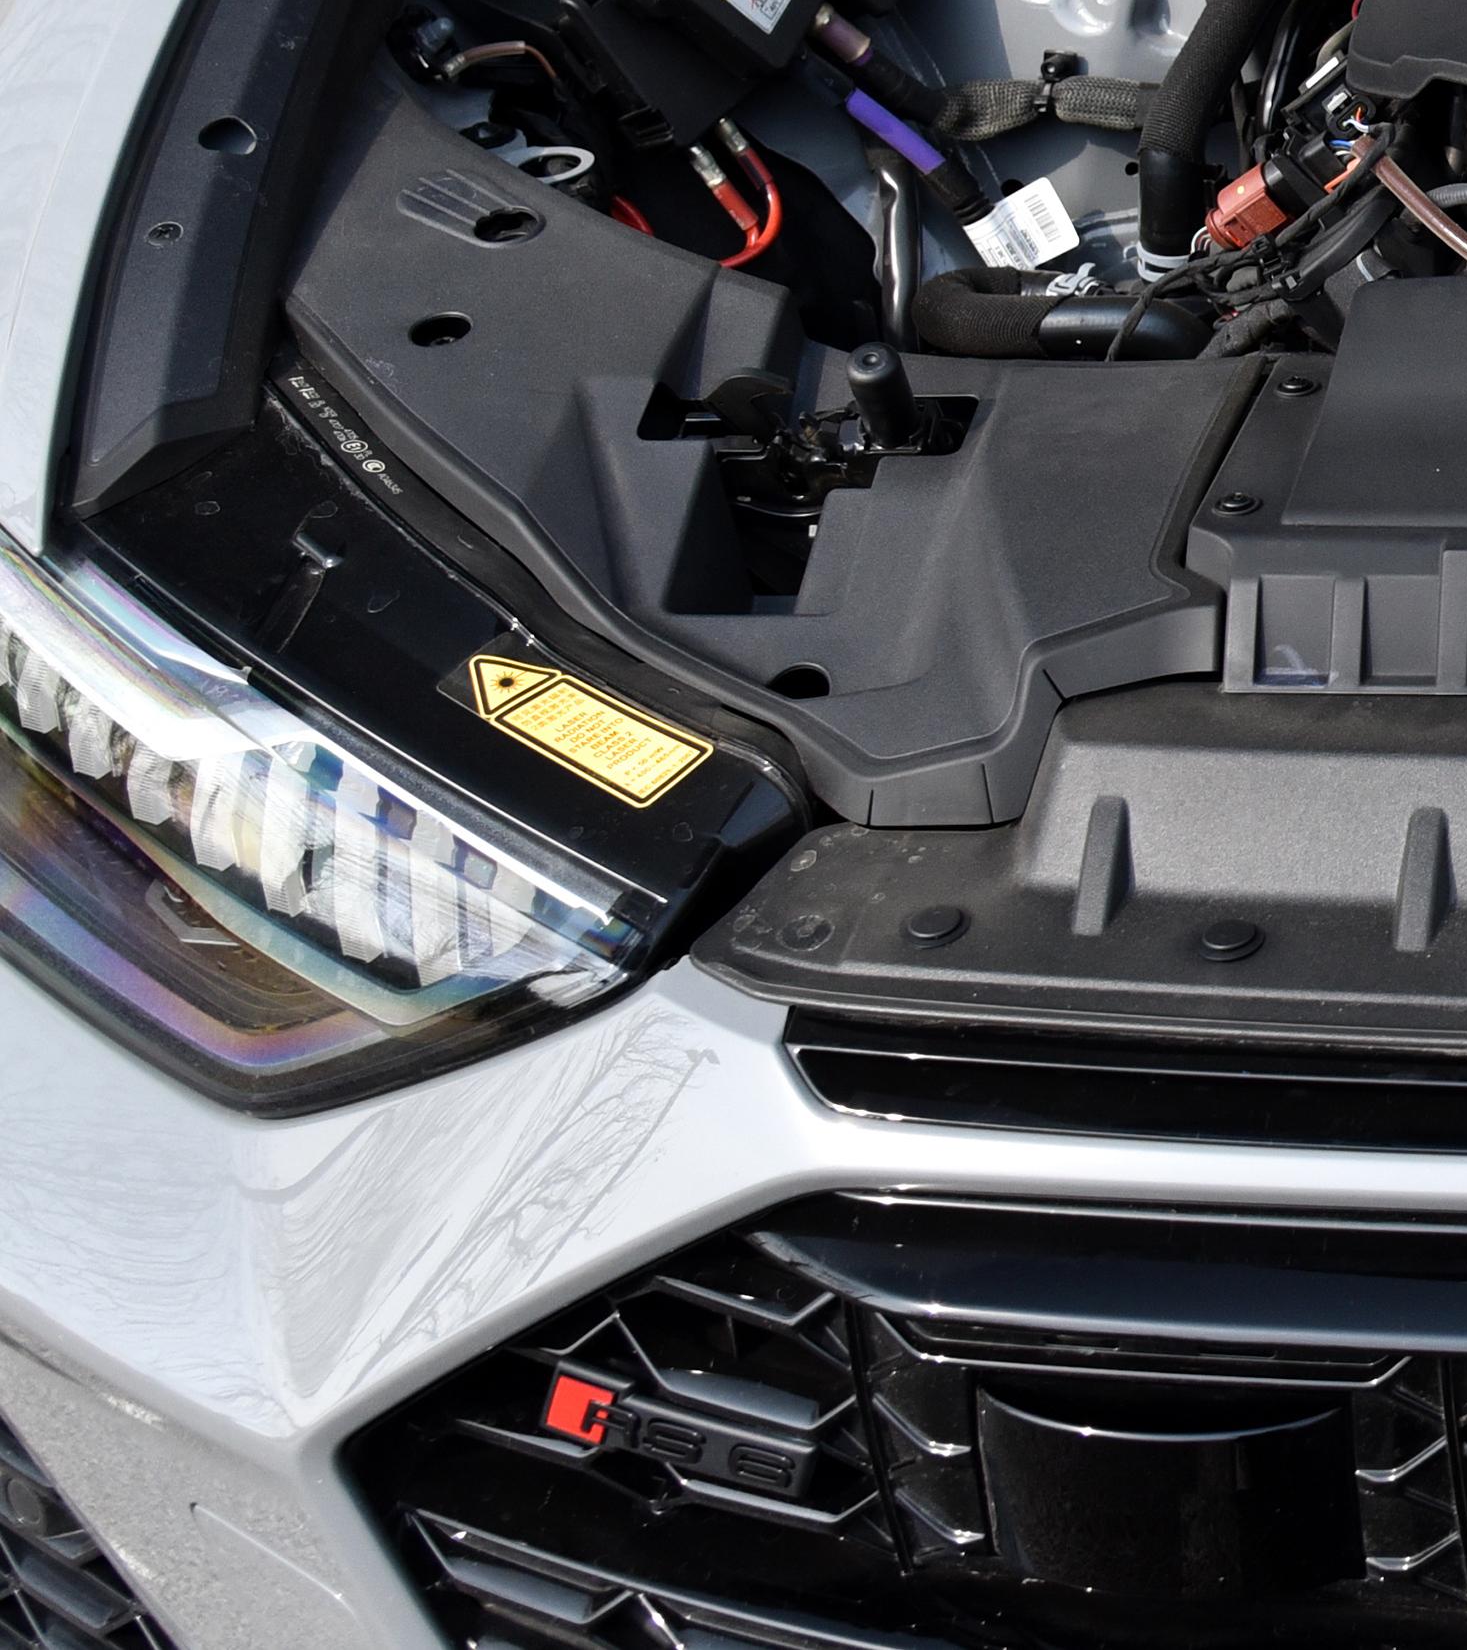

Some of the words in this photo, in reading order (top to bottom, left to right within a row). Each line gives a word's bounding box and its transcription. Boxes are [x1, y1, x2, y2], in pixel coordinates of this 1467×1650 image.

[553, 711, 588, 732] LASER
[553, 709, 606, 743] RADIATION
[568, 732, 587, 743] DO
[584, 718, 607, 733] NOT
[567, 732, 601, 753] STARE
[598, 717, 625, 733] INTO
[589, 729, 620, 750] BEAM
[592, 735, 627, 758] CLASS
[604, 737, 638, 760] LASER
[604, 736, 653, 770] PRODUCT
